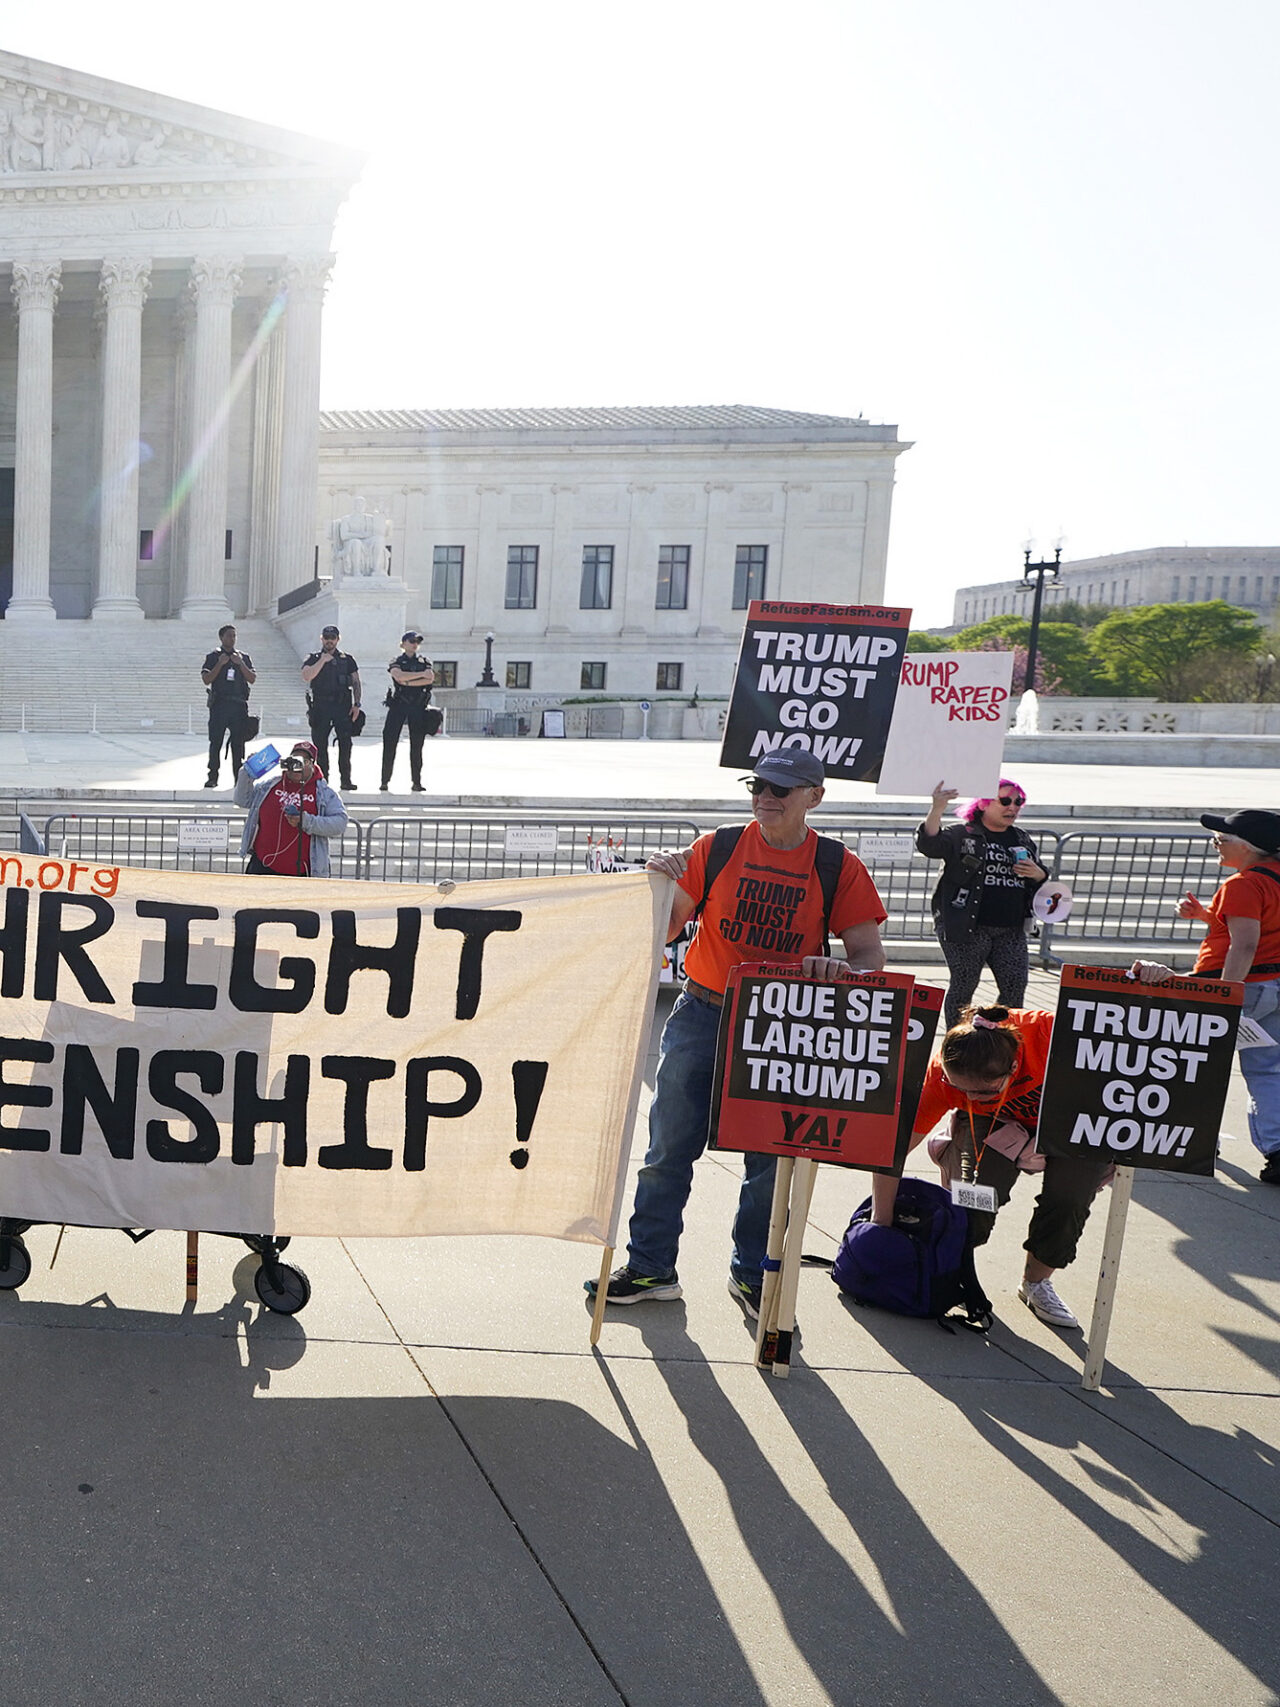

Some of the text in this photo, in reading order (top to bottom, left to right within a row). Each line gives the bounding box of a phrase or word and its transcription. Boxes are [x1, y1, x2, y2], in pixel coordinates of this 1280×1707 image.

[760, 602, 900, 621] RefuseFascism.org
[752, 631, 897, 666] TRUMP
[757, 665, 877, 698] MUST
[900, 658, 959, 687] RUMP
[930, 686, 1008, 705] RAPED
[948, 703, 1001, 722] KIDS
[779, 699, 839, 730] GO
[736, 877, 807, 908] TRUMP
[735, 899, 797, 930] MUST
[719, 918, 805, 954] GO NOW!
[748, 982, 895, 1025] ¡QUE SE
[1067, 999, 1229, 1047] TRUMP
[742, 1018, 890, 1065] LARGUE
[1075, 1038, 1208, 1083] MUST
[746, 1057, 881, 1102] TRUMP
[1102, 1080, 1170, 1117] GO
[780, 1110, 849, 1148] YA!
[1069, 1113, 1195, 1158] NOW!
